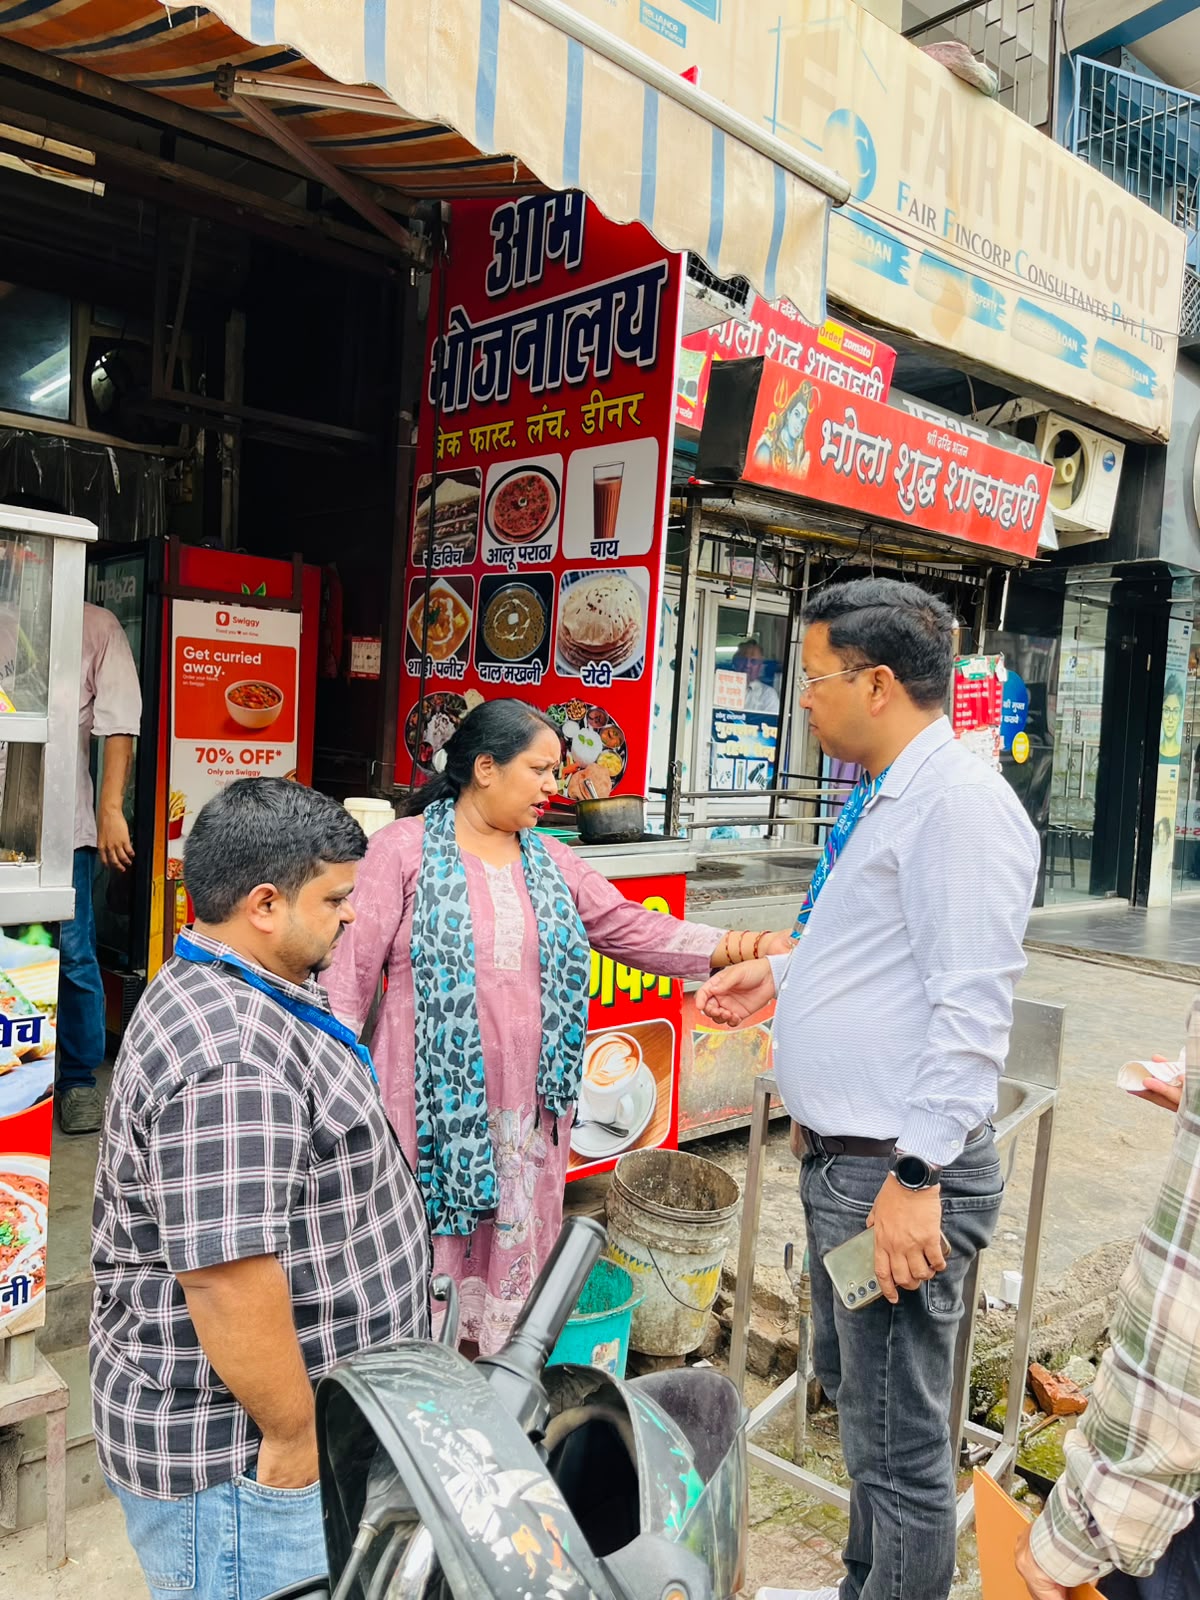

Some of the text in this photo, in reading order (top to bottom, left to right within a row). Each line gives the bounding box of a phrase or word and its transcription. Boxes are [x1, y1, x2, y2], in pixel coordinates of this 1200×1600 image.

[899, 62, 1170, 316] FAIR FINCORP
[895, 180, 937, 232] FAIR
[943, 209, 1013, 270] FINCORP
[1014, 249, 1110, 322] CONSULTANTS
[1111, 301, 1138, 341] PVT.
[1139, 317, 1168, 355] LTD.
[428, 258, 669, 413] भोजनालय
[820, 325, 872, 359] Order zomato
[581, 389, 644, 435] डीनर
[820, 406, 892, 487] भोला
[892, 442, 943, 516] शुद्ध
[942, 459, 1041, 532] शाकाहारी
[486, 543, 553, 572] आलू पराठा
[591, 539, 619, 560] चाय
[232, 615, 260, 628] Swiggy
[183, 646, 262, 665] Get curried
[435, 656, 465, 679] पनीर
[183, 663, 226, 678] away.
[479, 658, 543, 684] दाल मखनी
[582, 662, 613, 687] रोटी
[195, 747, 234, 764] 70%
[207, 768, 224, 777] Only
[235, 768, 261, 777] Swiggy
